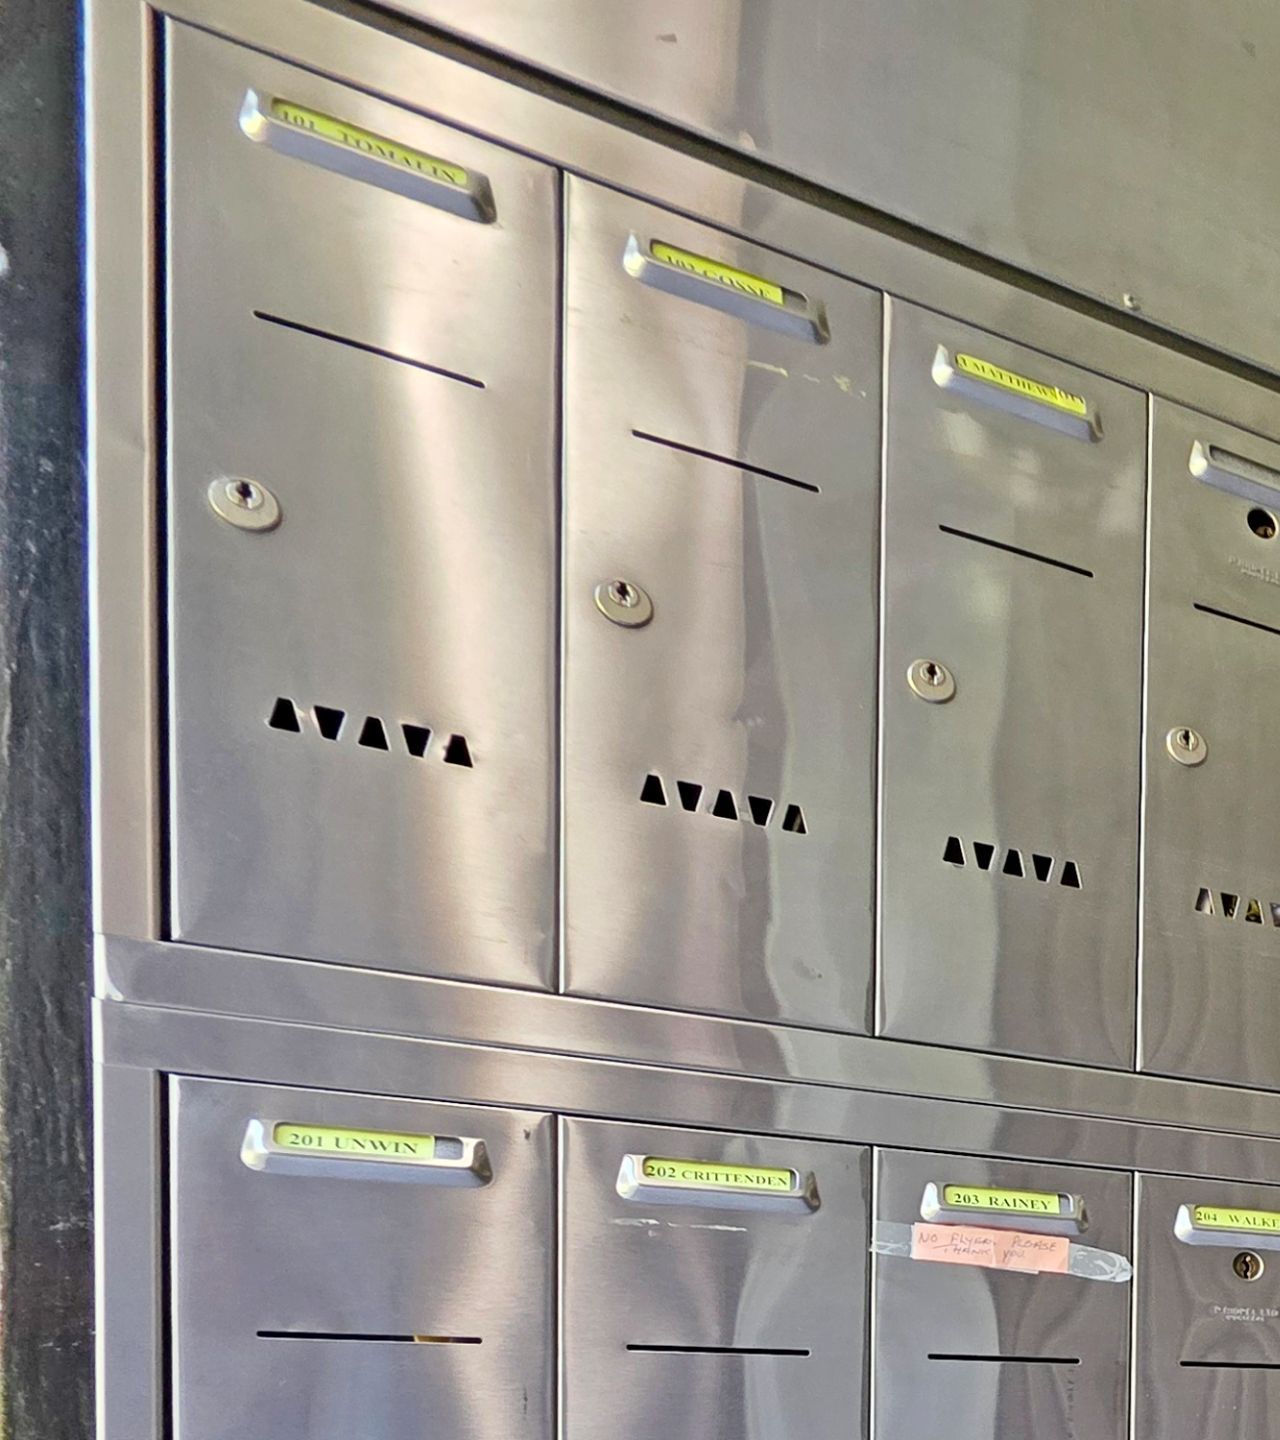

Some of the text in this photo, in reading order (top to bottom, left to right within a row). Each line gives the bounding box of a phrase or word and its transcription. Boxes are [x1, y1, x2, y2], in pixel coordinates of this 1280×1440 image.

[336, 129, 459, 184] TOMALIN
[289, 1132, 419, 1155] 201 UNWIN
[646, 1164, 790, 1187] 202 CRITTENDEN
[953, 1192, 1052, 1211] 203 RAINEY
[1195, 1211, 1218, 1222] 204
